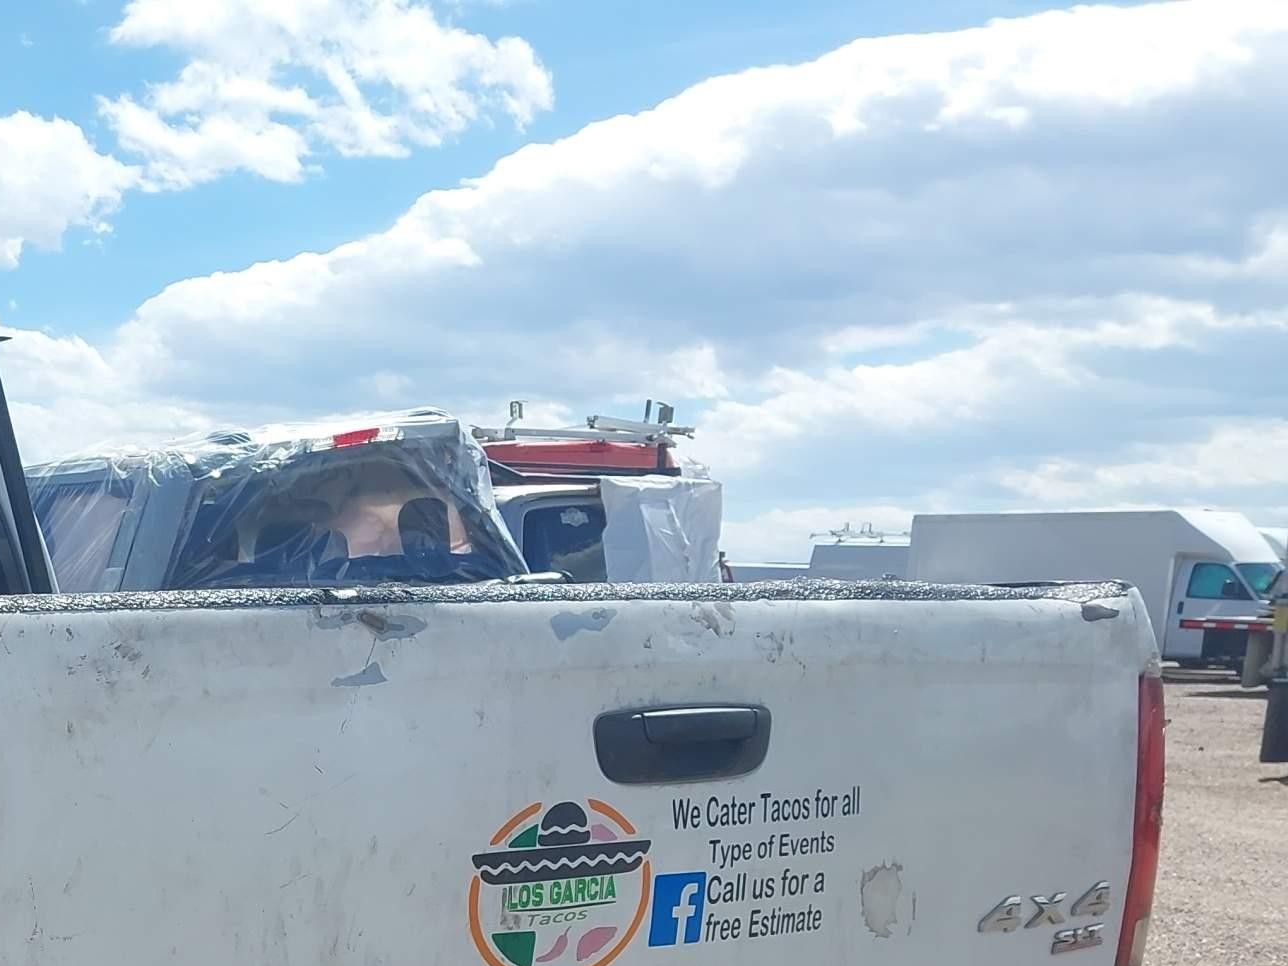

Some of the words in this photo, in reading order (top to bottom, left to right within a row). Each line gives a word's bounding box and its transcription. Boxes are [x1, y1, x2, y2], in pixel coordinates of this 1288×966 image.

[672, 798, 701, 830] We
[706, 795, 756, 828] Cater
[760, 792, 810, 823] Tacos
[814, 789, 838, 819] for
[842, 785, 861, 817] all
[709, 839, 752, 869] Type
[757, 834, 776, 859] of
[778, 830, 835, 857] Events
[508, 882, 545, 909] LOS
[549, 875, 617, 906] GARCIA
[707, 872, 747, 905] Call
[752, 877, 775, 899] us
[780, 867, 810, 897] for
[813, 871, 825, 893] a
[527, 909, 589, 928] Tacos
[705, 912, 742, 943] free
[748, 903, 822, 938] Estimate
